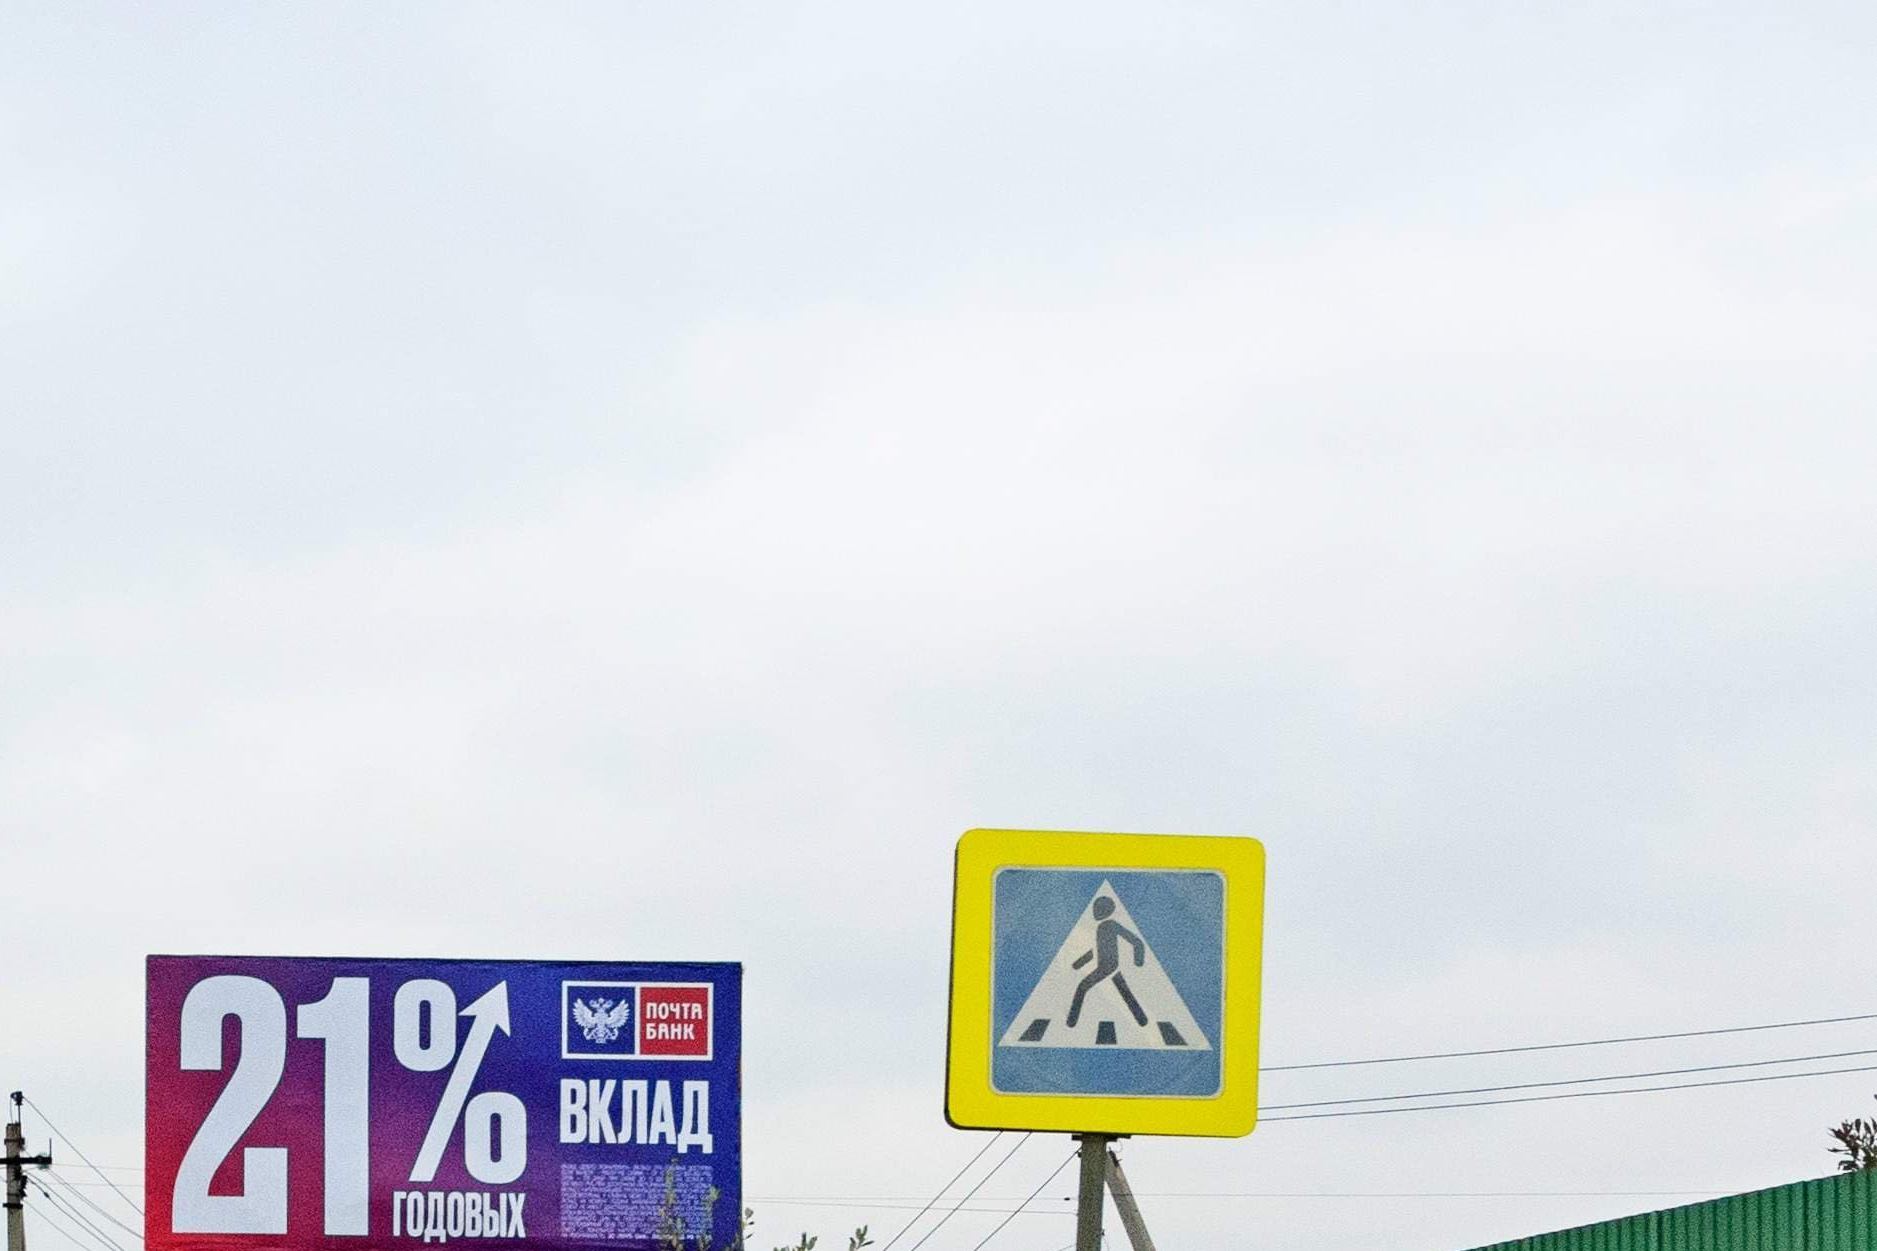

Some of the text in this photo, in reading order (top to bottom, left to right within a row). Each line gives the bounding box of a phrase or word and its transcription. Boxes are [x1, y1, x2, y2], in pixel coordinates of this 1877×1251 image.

[646, 1002, 702, 1019] ПОЧТА
[646, 1023, 695, 1040] БАНК
[172, 974, 528, 1236] 21%
[560, 1079, 713, 1153] ВКЛАД
[393, 1191, 526, 1242] ГОДОВЫХ
